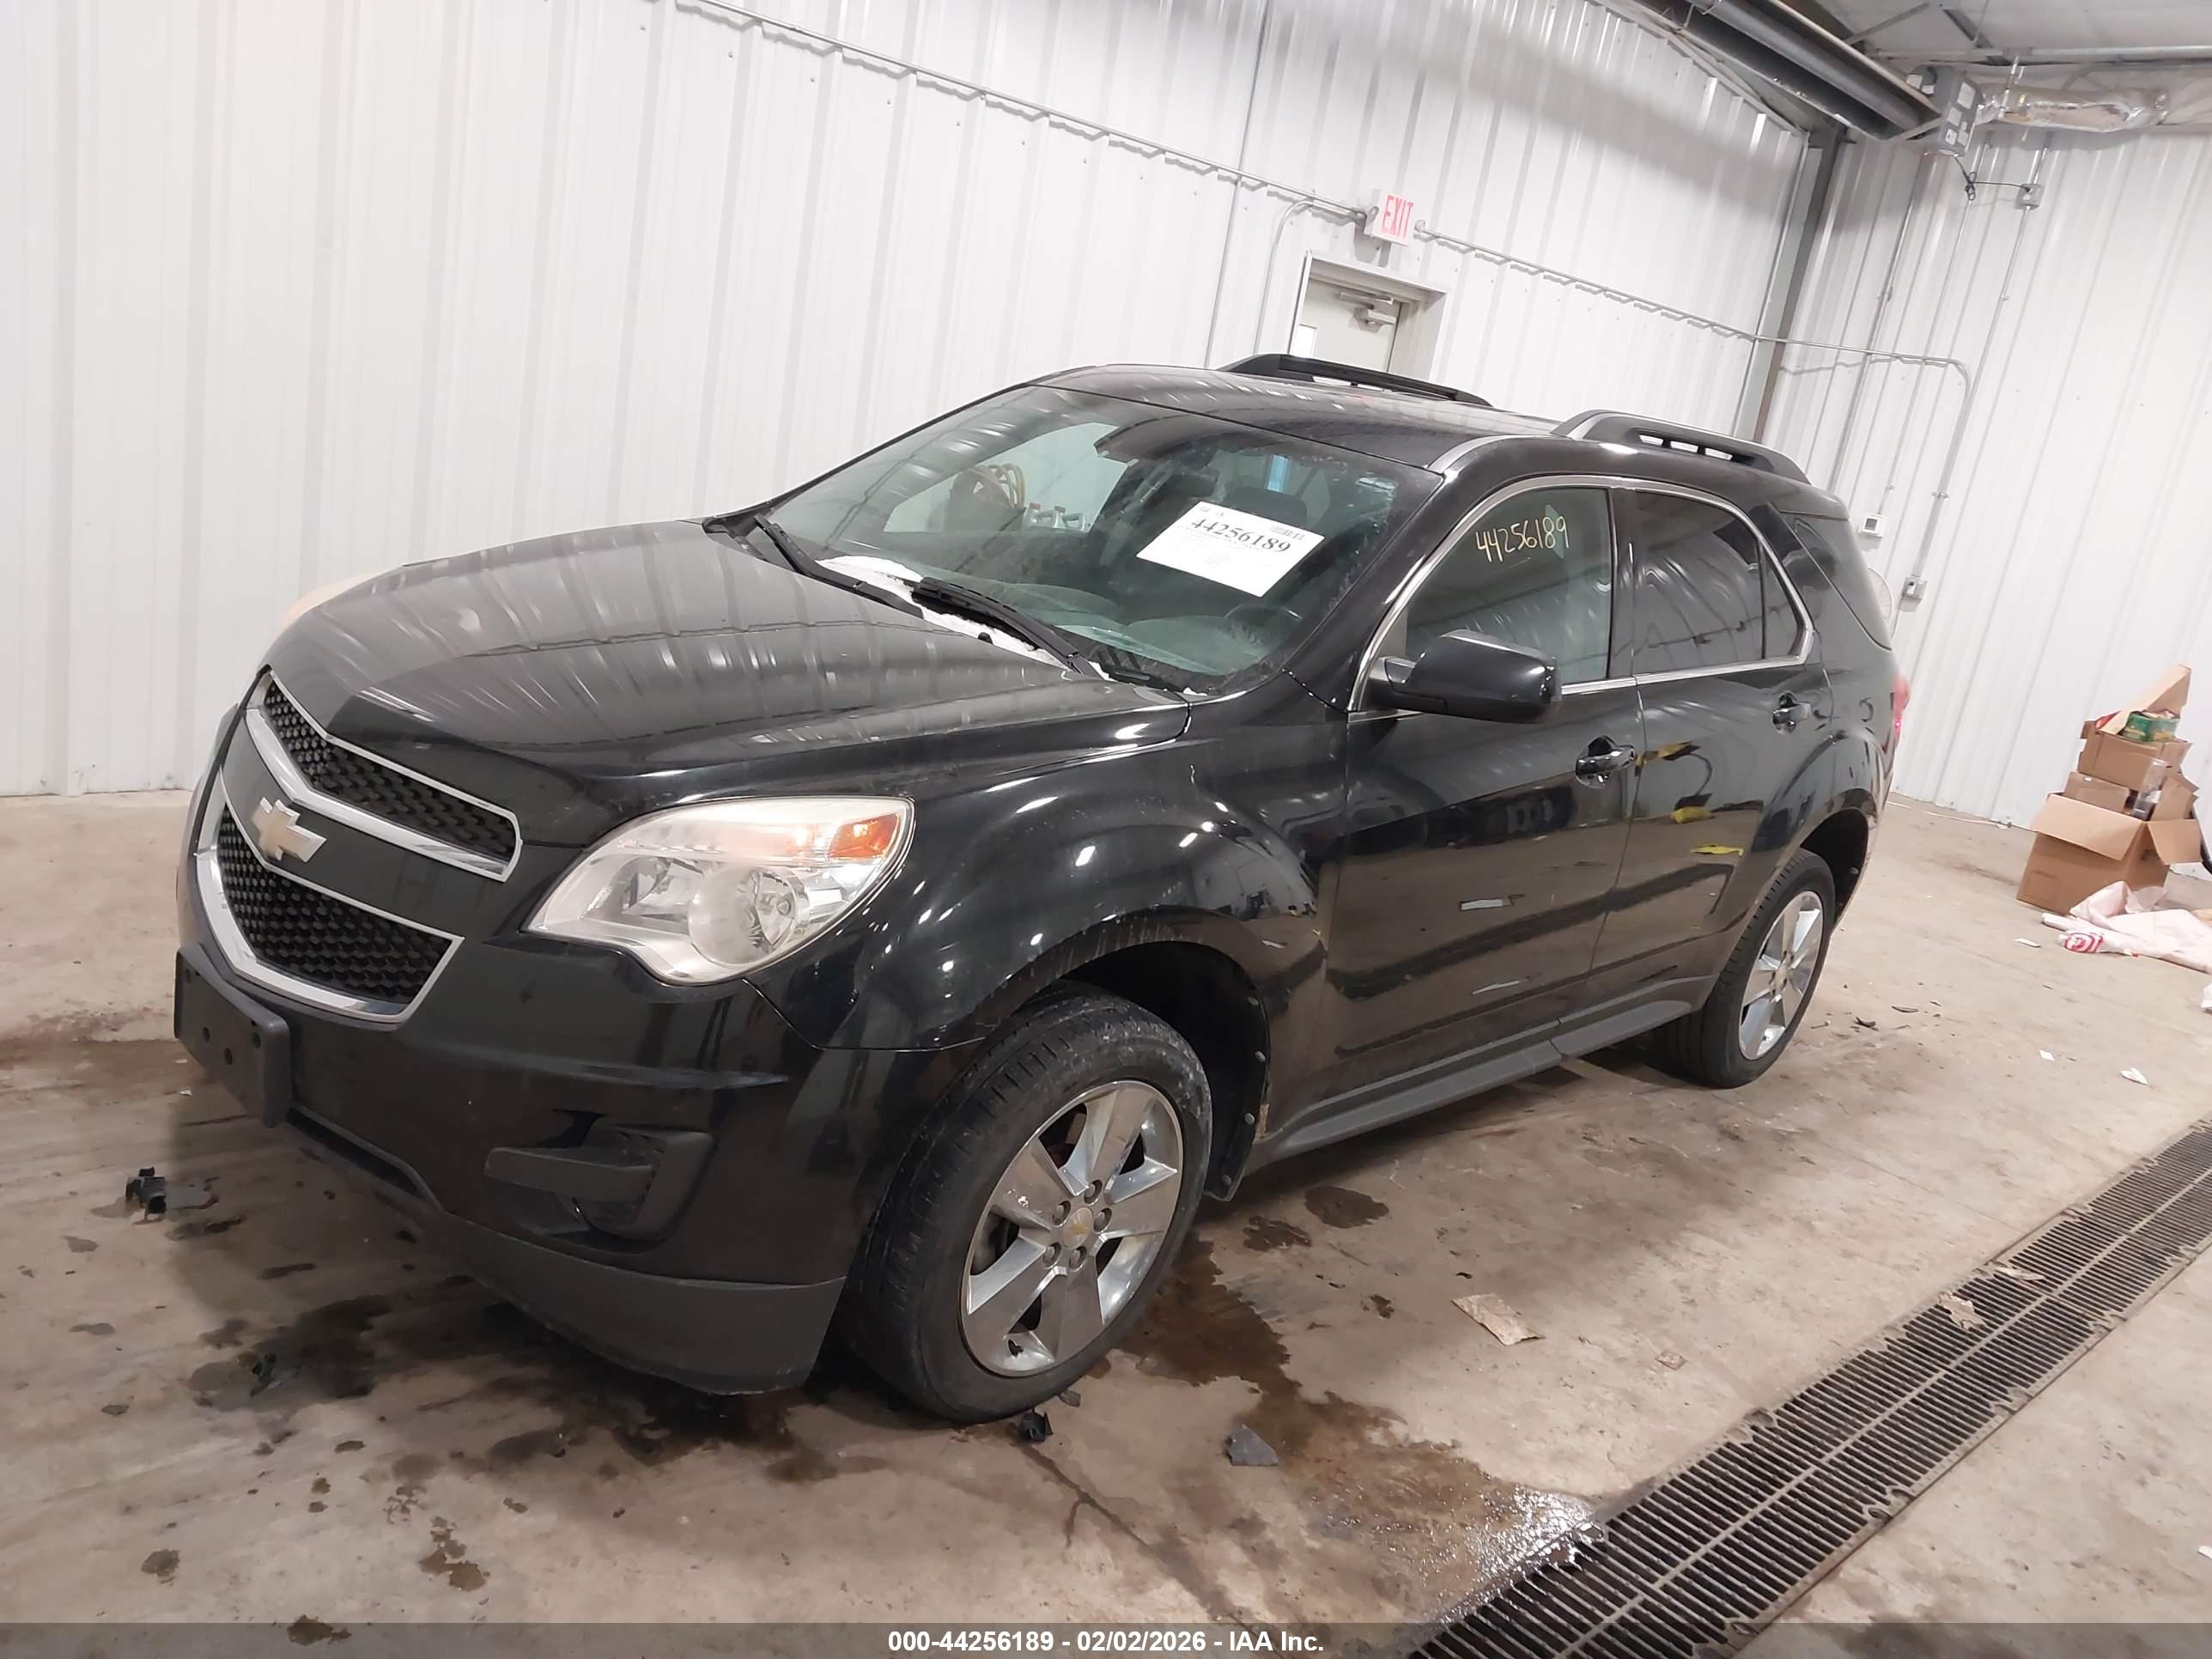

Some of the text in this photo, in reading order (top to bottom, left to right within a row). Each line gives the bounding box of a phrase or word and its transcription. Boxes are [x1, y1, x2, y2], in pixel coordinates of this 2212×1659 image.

[1381, 195, 1414, 239] EXIT
[1191, 519, 1291, 552] 44256189
[1475, 515, 1570, 562] 44256189
